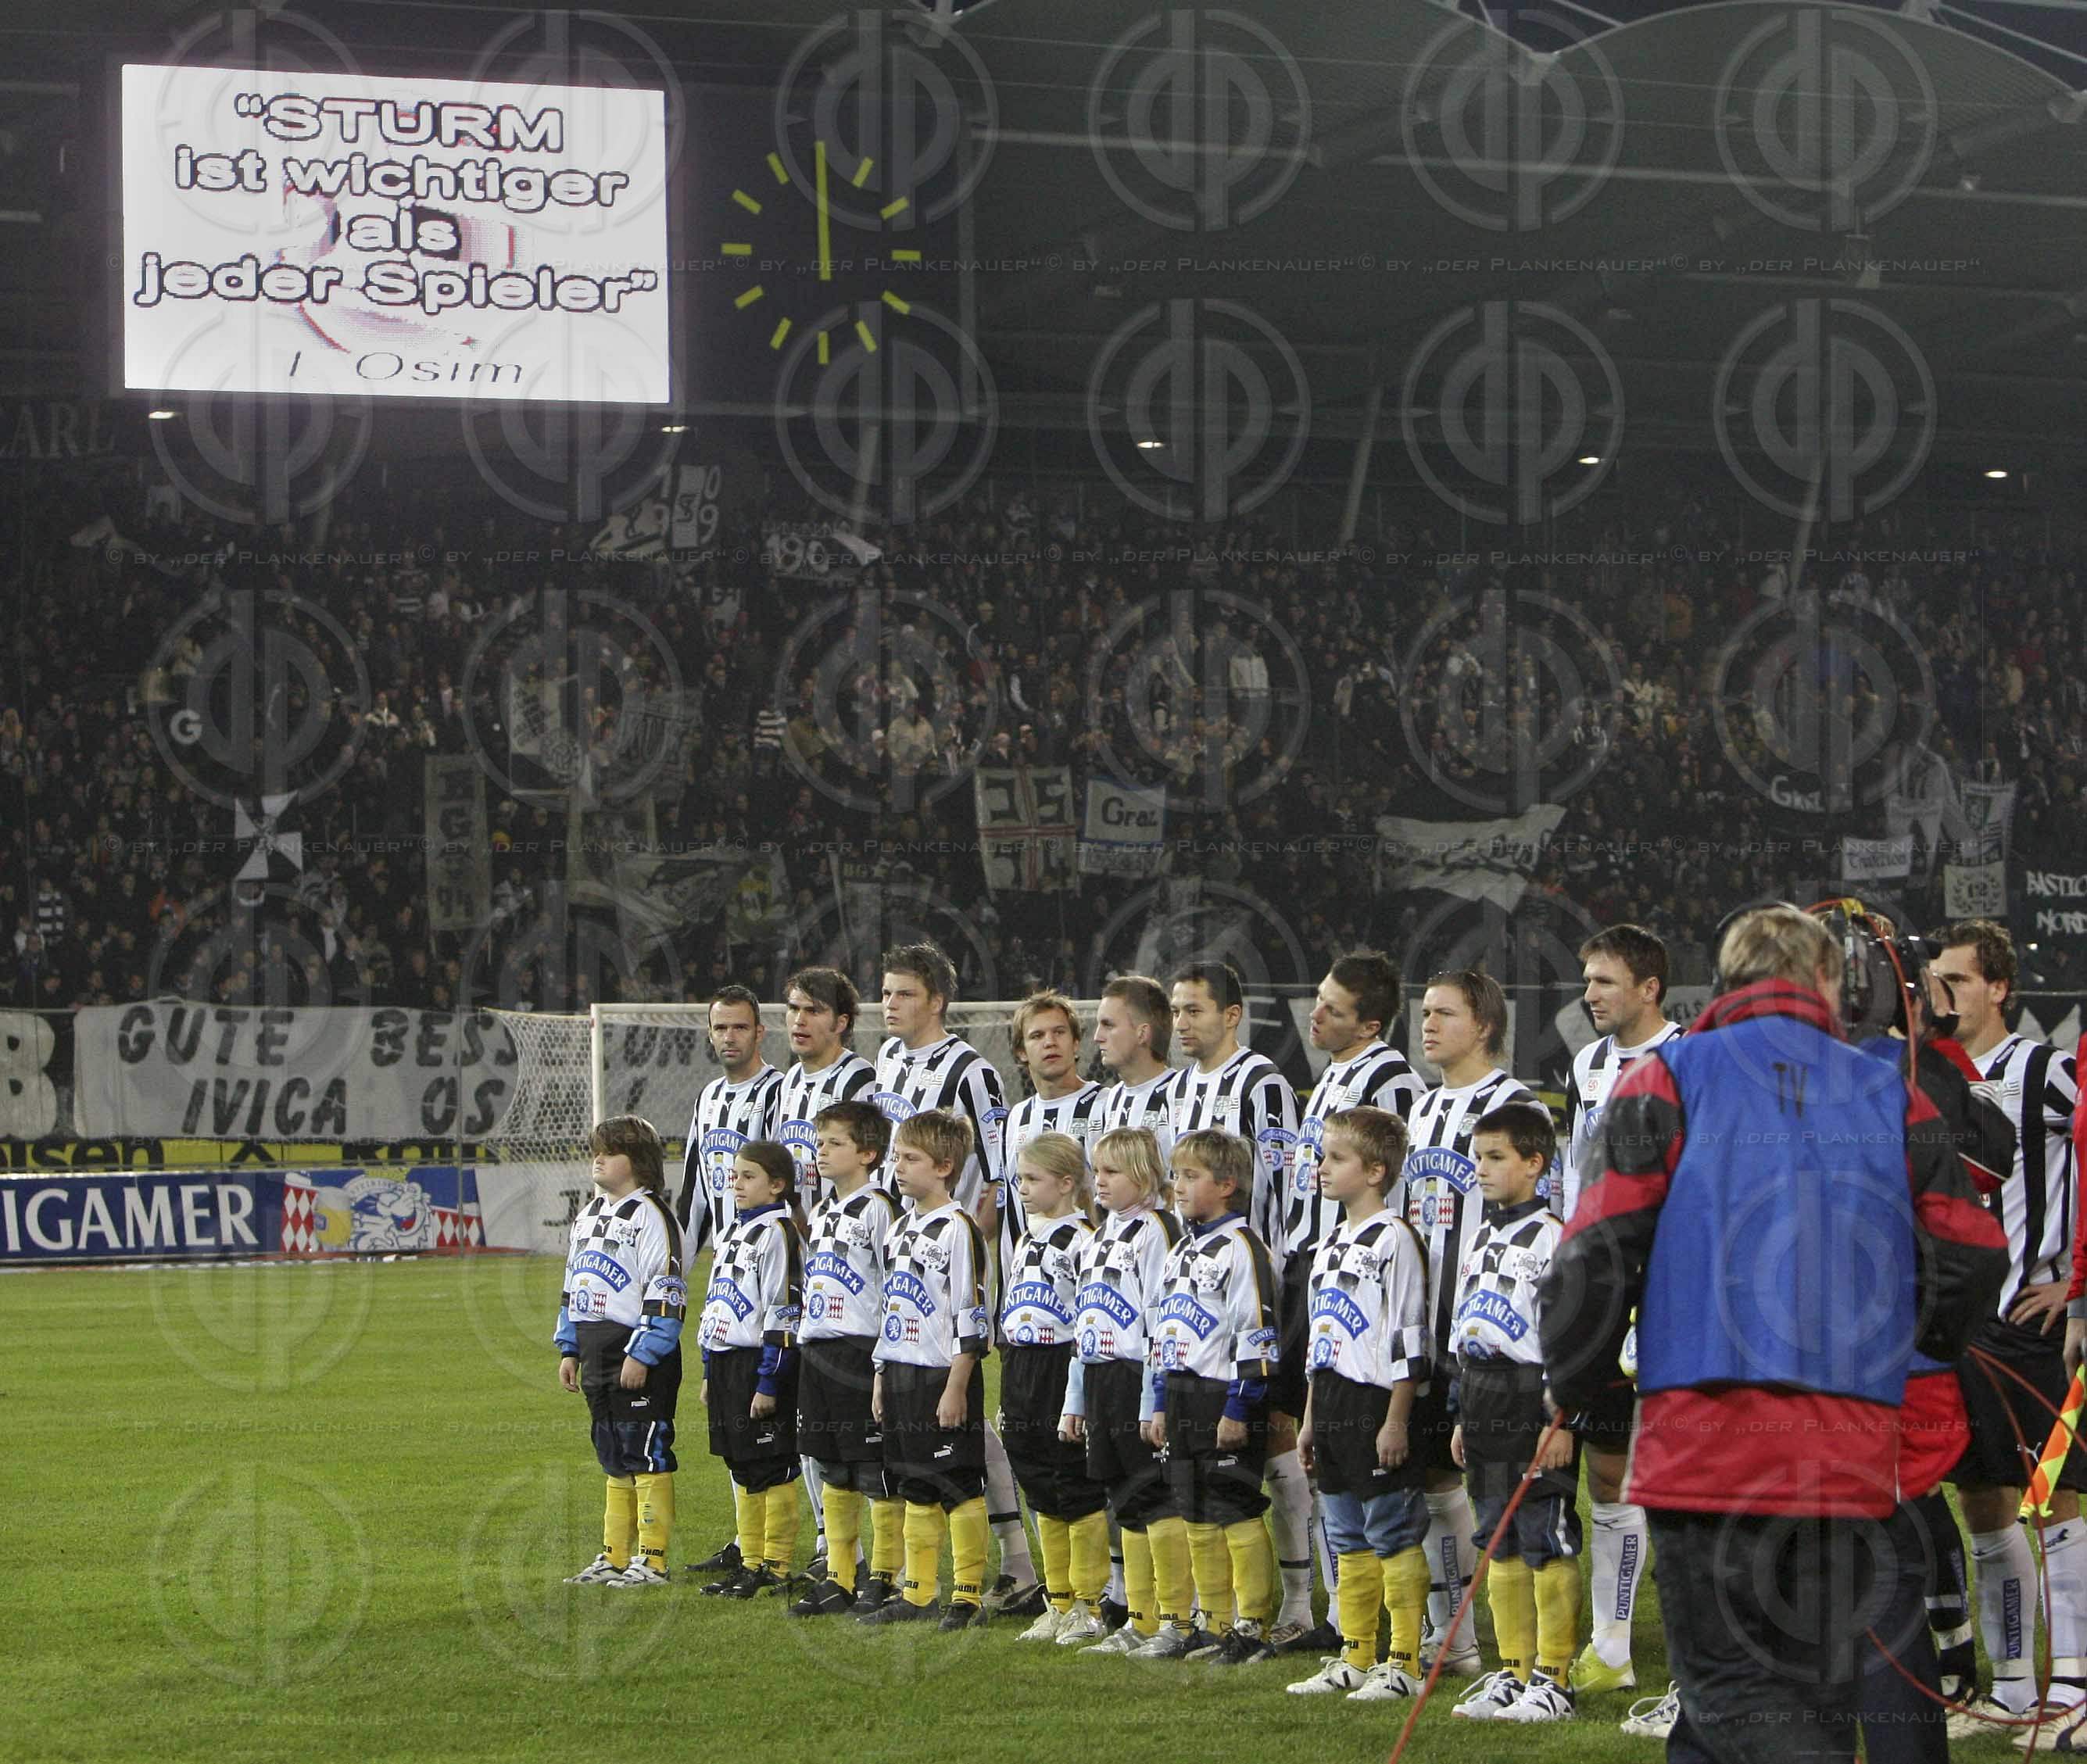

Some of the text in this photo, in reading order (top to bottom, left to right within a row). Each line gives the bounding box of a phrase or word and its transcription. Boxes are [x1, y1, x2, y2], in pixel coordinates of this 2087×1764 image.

[174, 144, 629, 213] ist wichtiger
[347, 206, 460, 255] als
[134, 252, 343, 306] jeder
[355, 351, 523, 384] Osim
[118, 1005, 295, 1065] GUTE
[181, 1076, 347, 1136] IVICA
[1772, 1061, 1809, 1118] TV
[1616, 1534, 1638, 1620] PUNTIGAMER
